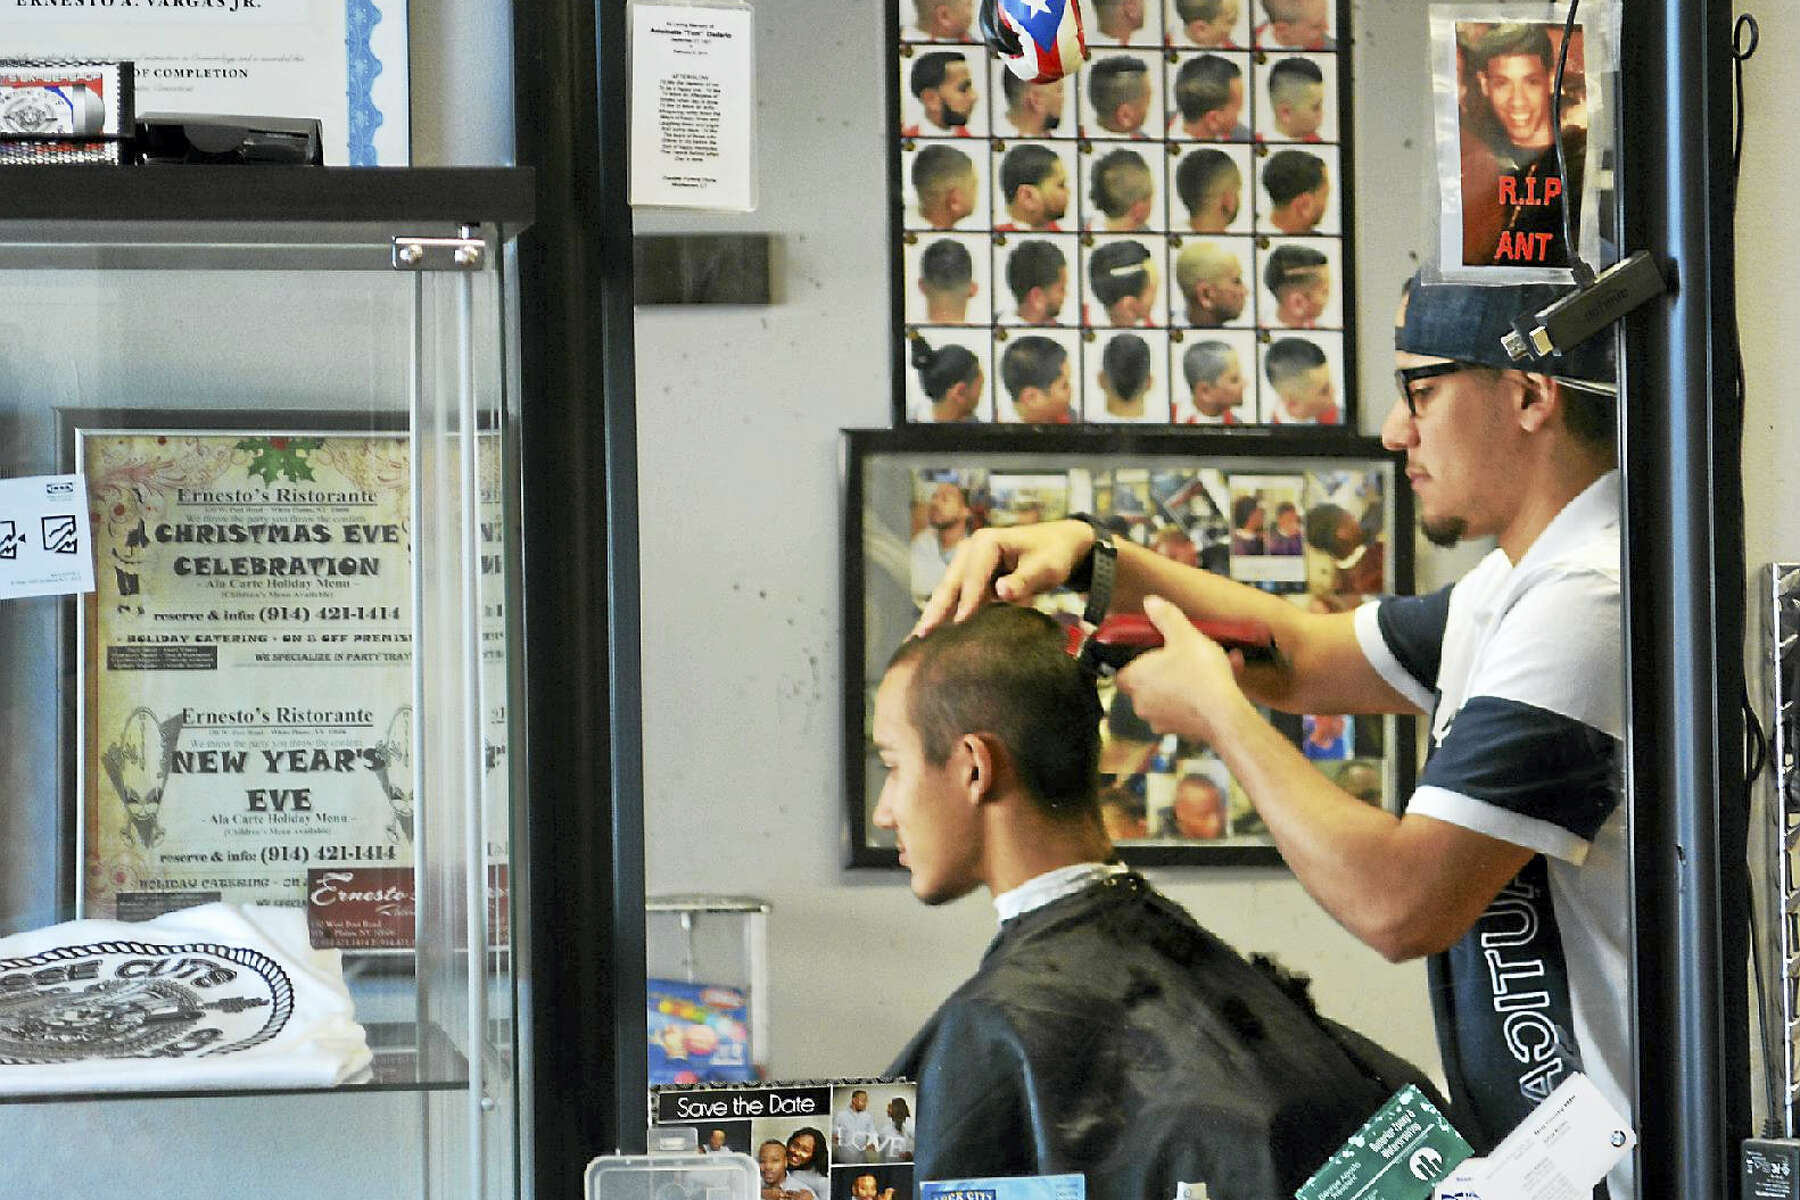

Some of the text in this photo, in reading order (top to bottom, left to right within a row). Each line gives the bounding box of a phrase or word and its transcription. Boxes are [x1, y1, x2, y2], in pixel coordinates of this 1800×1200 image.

[153, 68, 249, 79] COMPLETION
[1499, 176, 1562, 206] R.I.P
[1494, 230, 1554, 262] ANT
[177, 488, 377, 502] Ernesto's Ristorante
[155, 523, 399, 544] CHRISTMAS EVE
[173, 556, 380, 576] CELEBRATION
[207, 578, 350, 591] Ala Carte Holiday Menu
[154, 612, 204, 622] reserve
[207, 611, 220, 621] &
[259, 606, 310, 623] (914)
[318, 606, 400, 620] 421-1414
[127, 634, 190, 643] HOLIDAY
[195, 634, 267, 643] CATERING
[182, 707, 374, 723] Ernesto's Ristorante
[171, 748, 385, 774] NEW YEAR'S
[246, 788, 312, 812] EVE
[211, 813, 348, 826] Ala Carte Holiday Menu
[160, 845, 396, 866] reserve & info: (914) 421-1414
[311, 872, 415, 906] Ernesto
[676, 1093, 816, 1118] Save the Date
